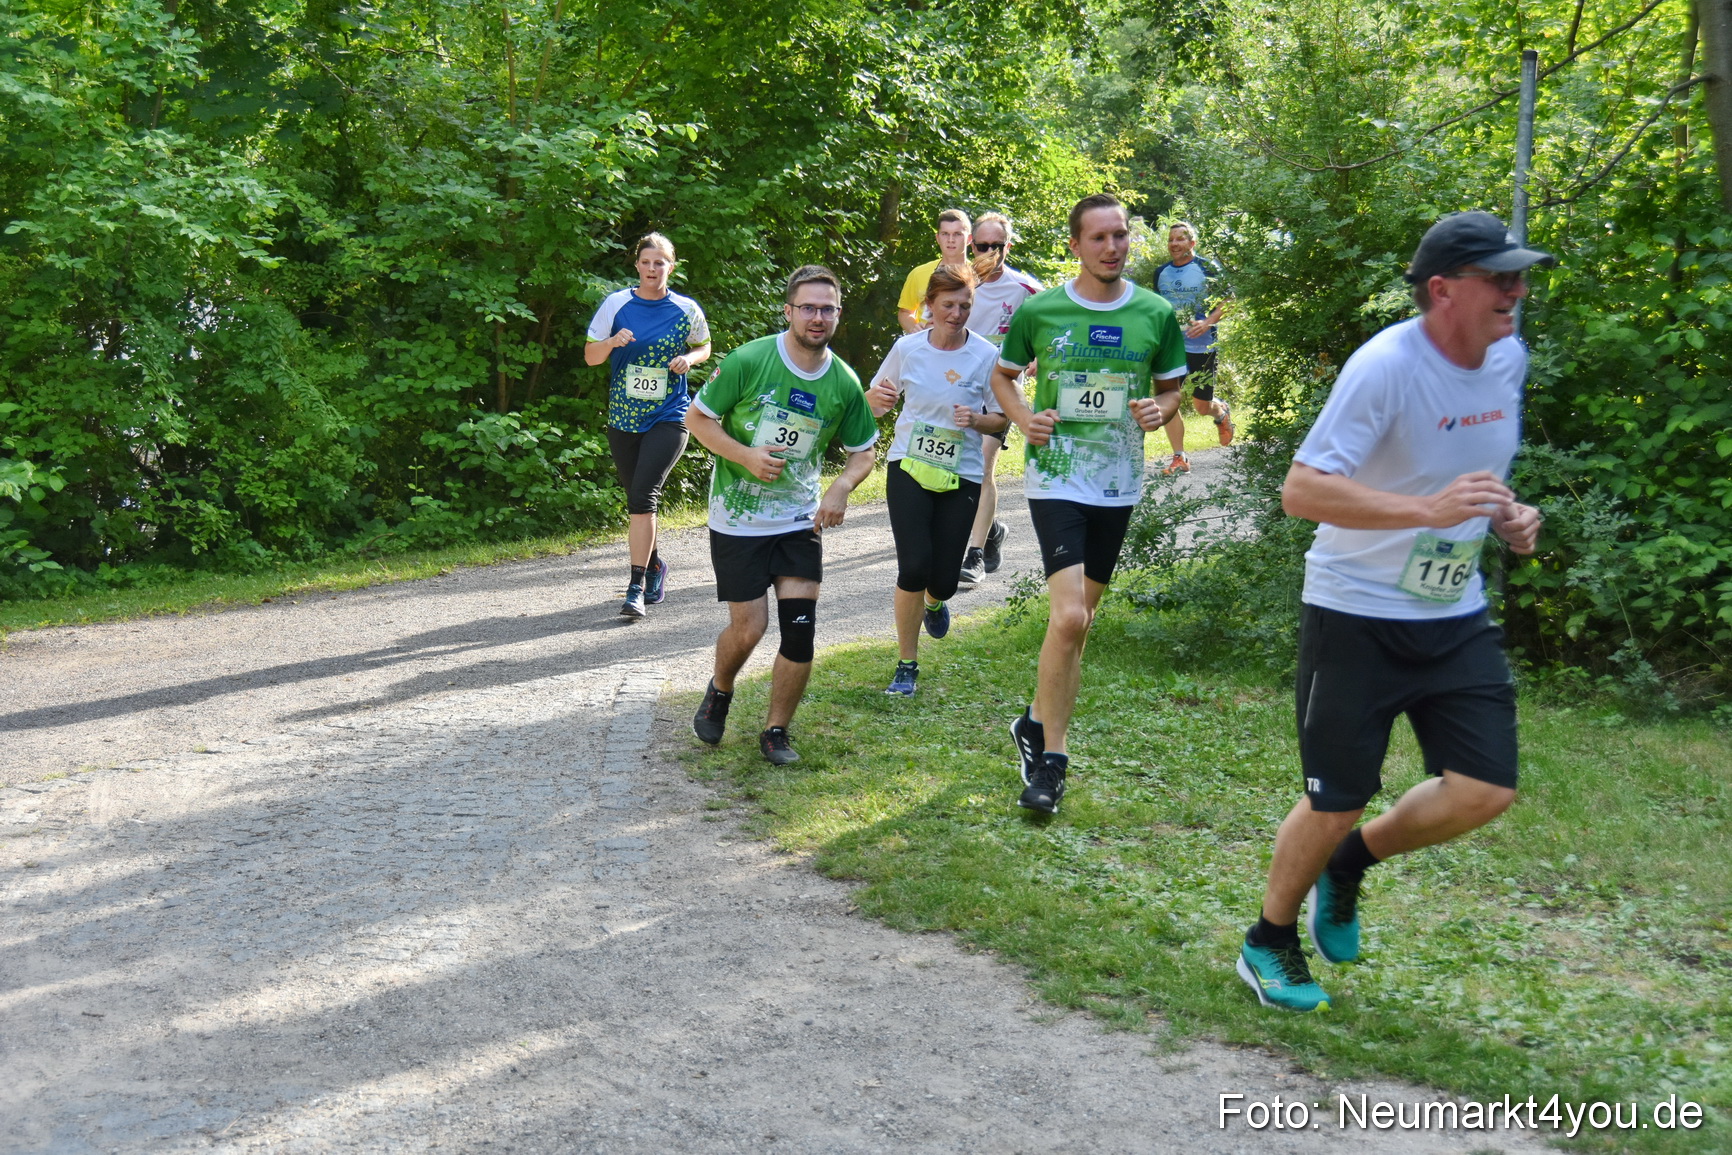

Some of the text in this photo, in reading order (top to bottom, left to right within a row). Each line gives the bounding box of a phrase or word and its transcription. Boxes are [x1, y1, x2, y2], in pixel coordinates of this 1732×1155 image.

[1095, 332, 1121, 341] Fischer
[1072, 342, 1150, 362] firmenlauf
[633, 377, 658, 391] 203
[794, 396, 814, 407] Fischer
[1078, 390, 1105, 409] 40
[1460, 409, 1506, 428] KLEBL
[775, 427, 799, 447] 39
[916, 436, 956, 458] 1354
